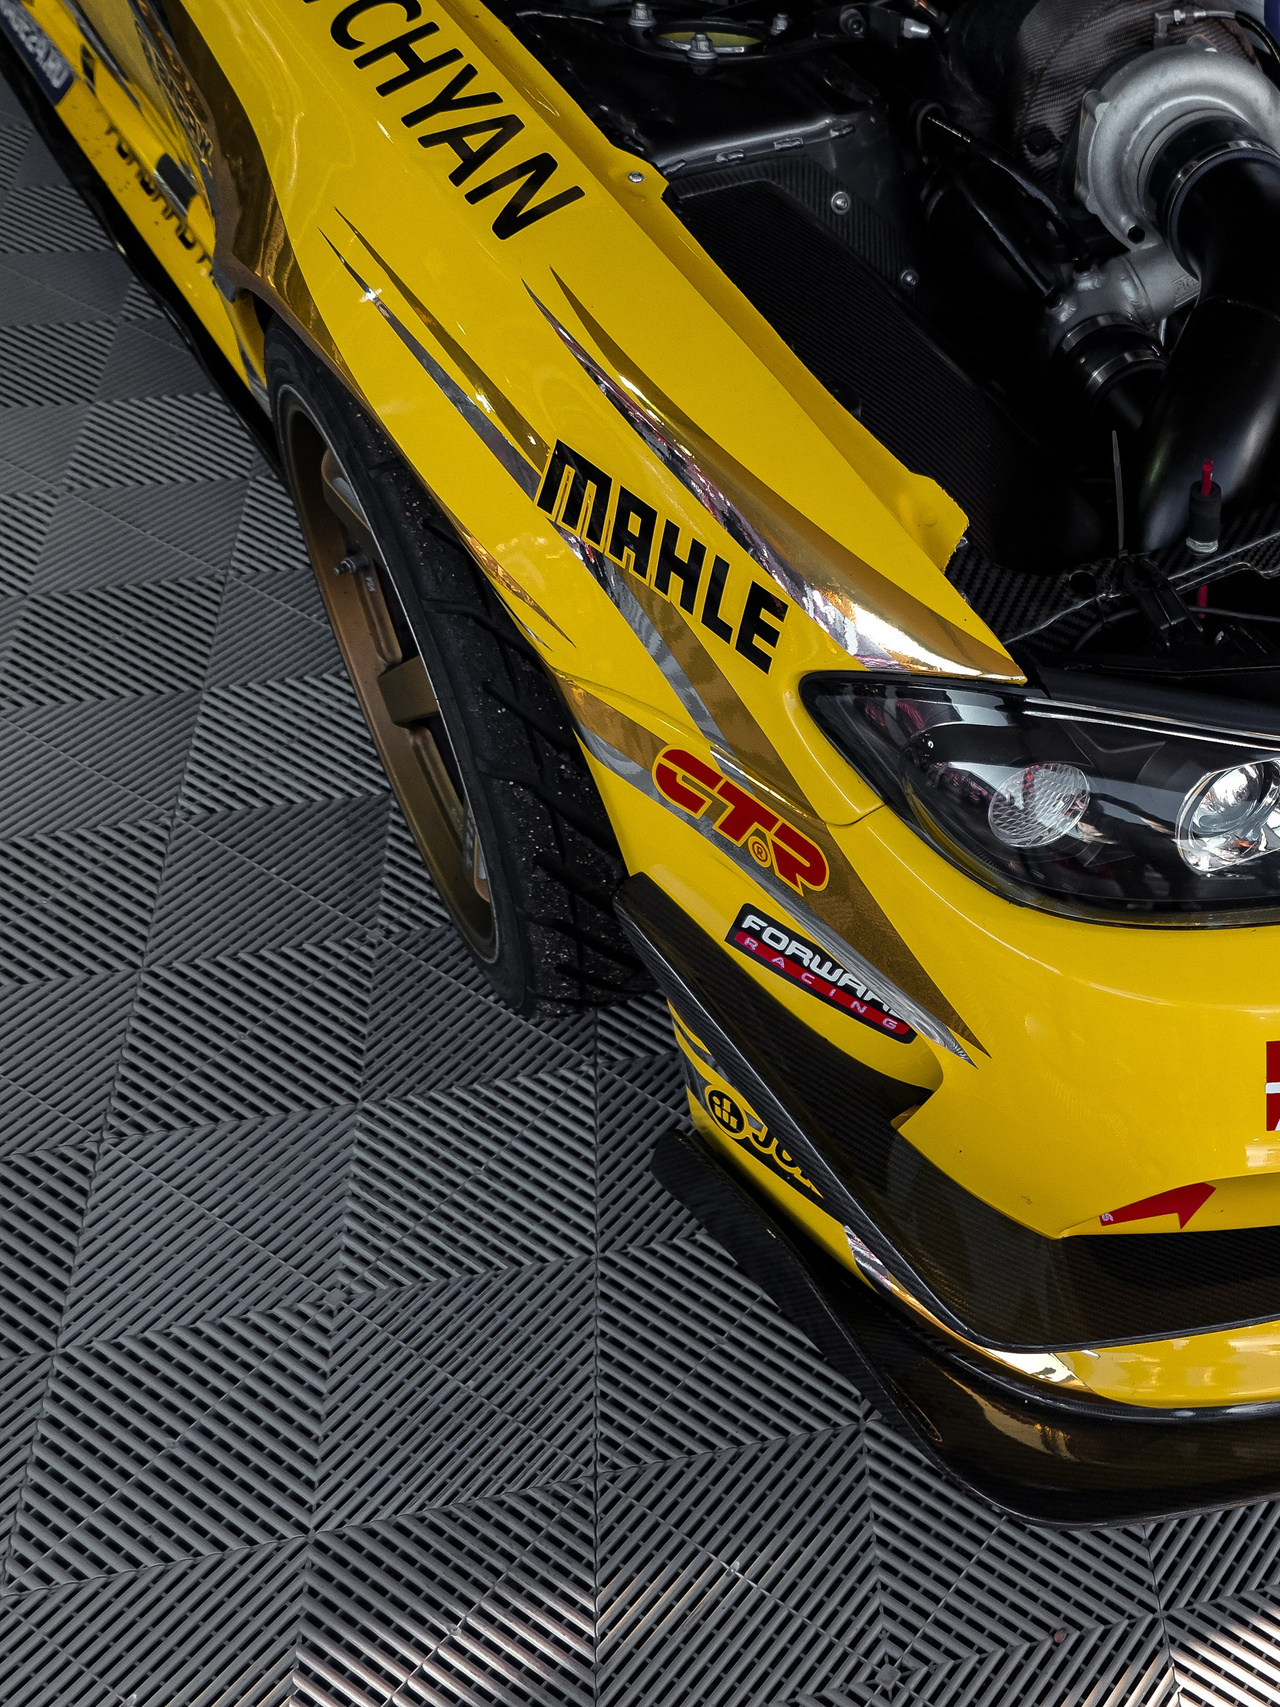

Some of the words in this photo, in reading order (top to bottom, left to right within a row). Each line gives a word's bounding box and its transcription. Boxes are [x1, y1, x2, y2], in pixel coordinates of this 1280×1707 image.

[537, 439, 789, 675] MAHLE
[741, 914, 903, 1020] FORWA
[744, 937, 898, 1030] RACING
